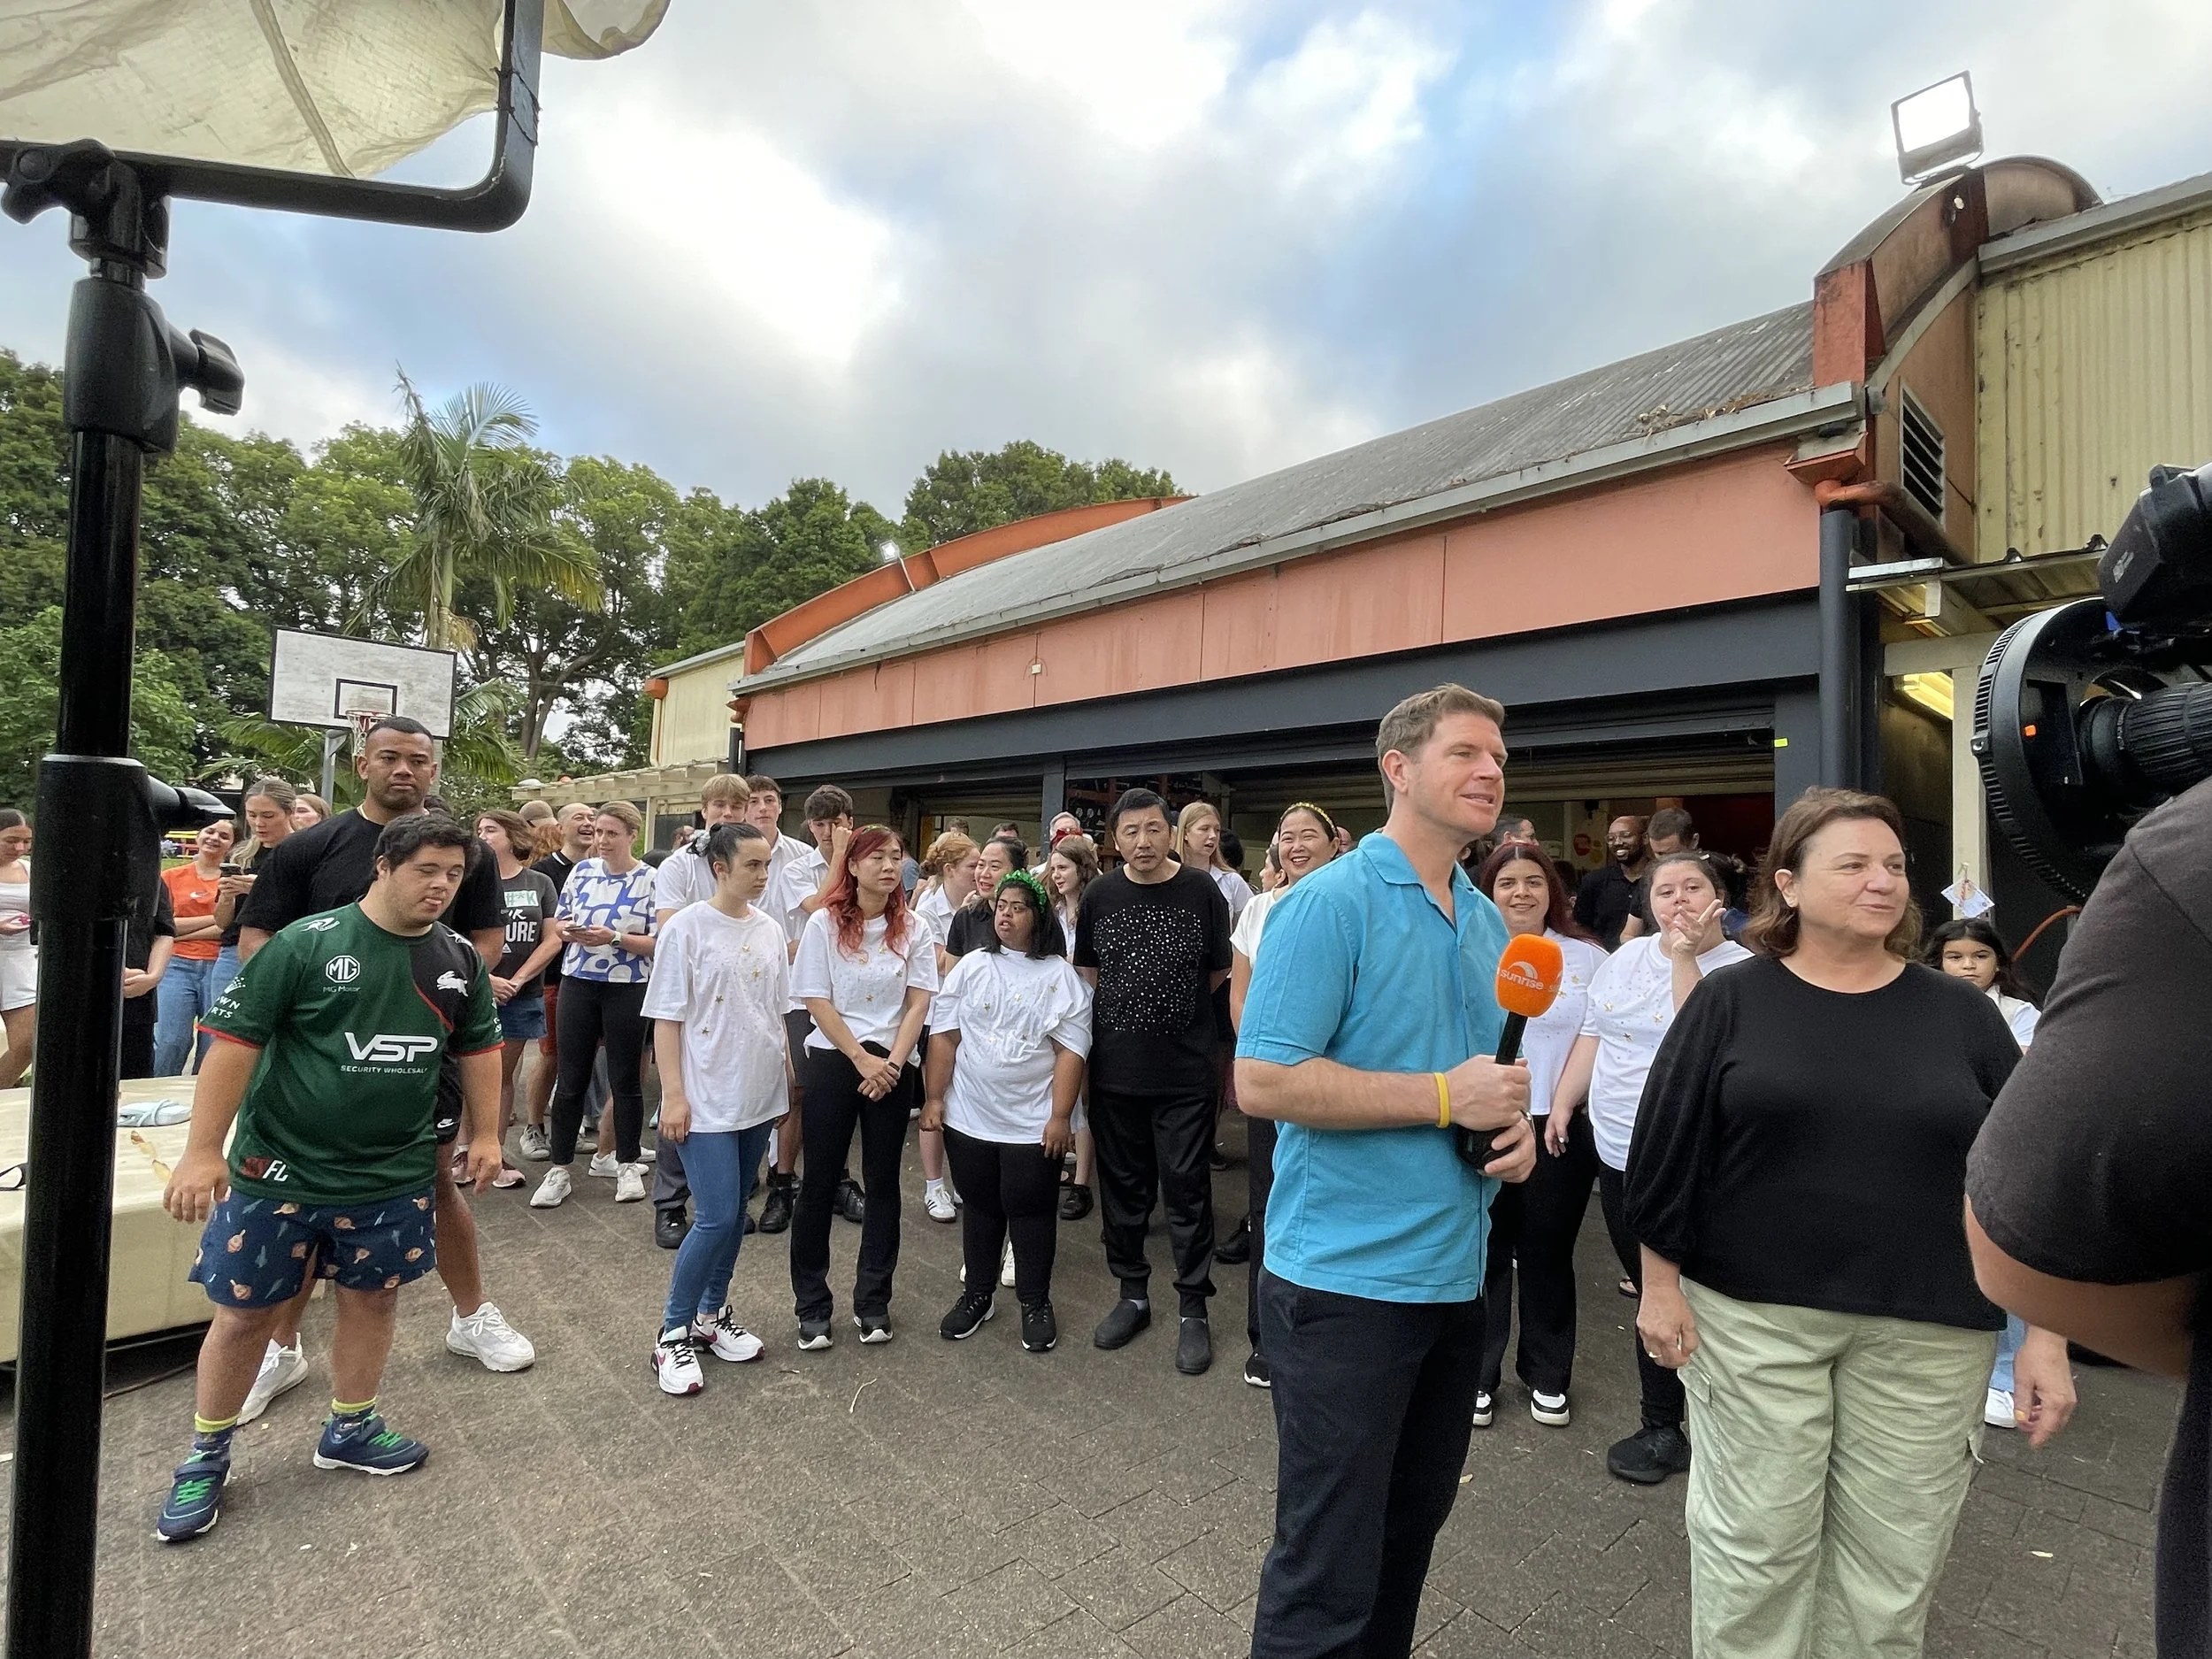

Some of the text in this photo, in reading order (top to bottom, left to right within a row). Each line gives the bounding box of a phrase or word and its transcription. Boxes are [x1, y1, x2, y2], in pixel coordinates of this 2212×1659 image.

[329, 957, 357, 980] MG
[1500, 969, 1544, 990] sunrise
[216, 995, 241, 1010] WN
[344, 1032, 438, 1063] VSP
[340, 1064, 381, 1073] SECURITY
